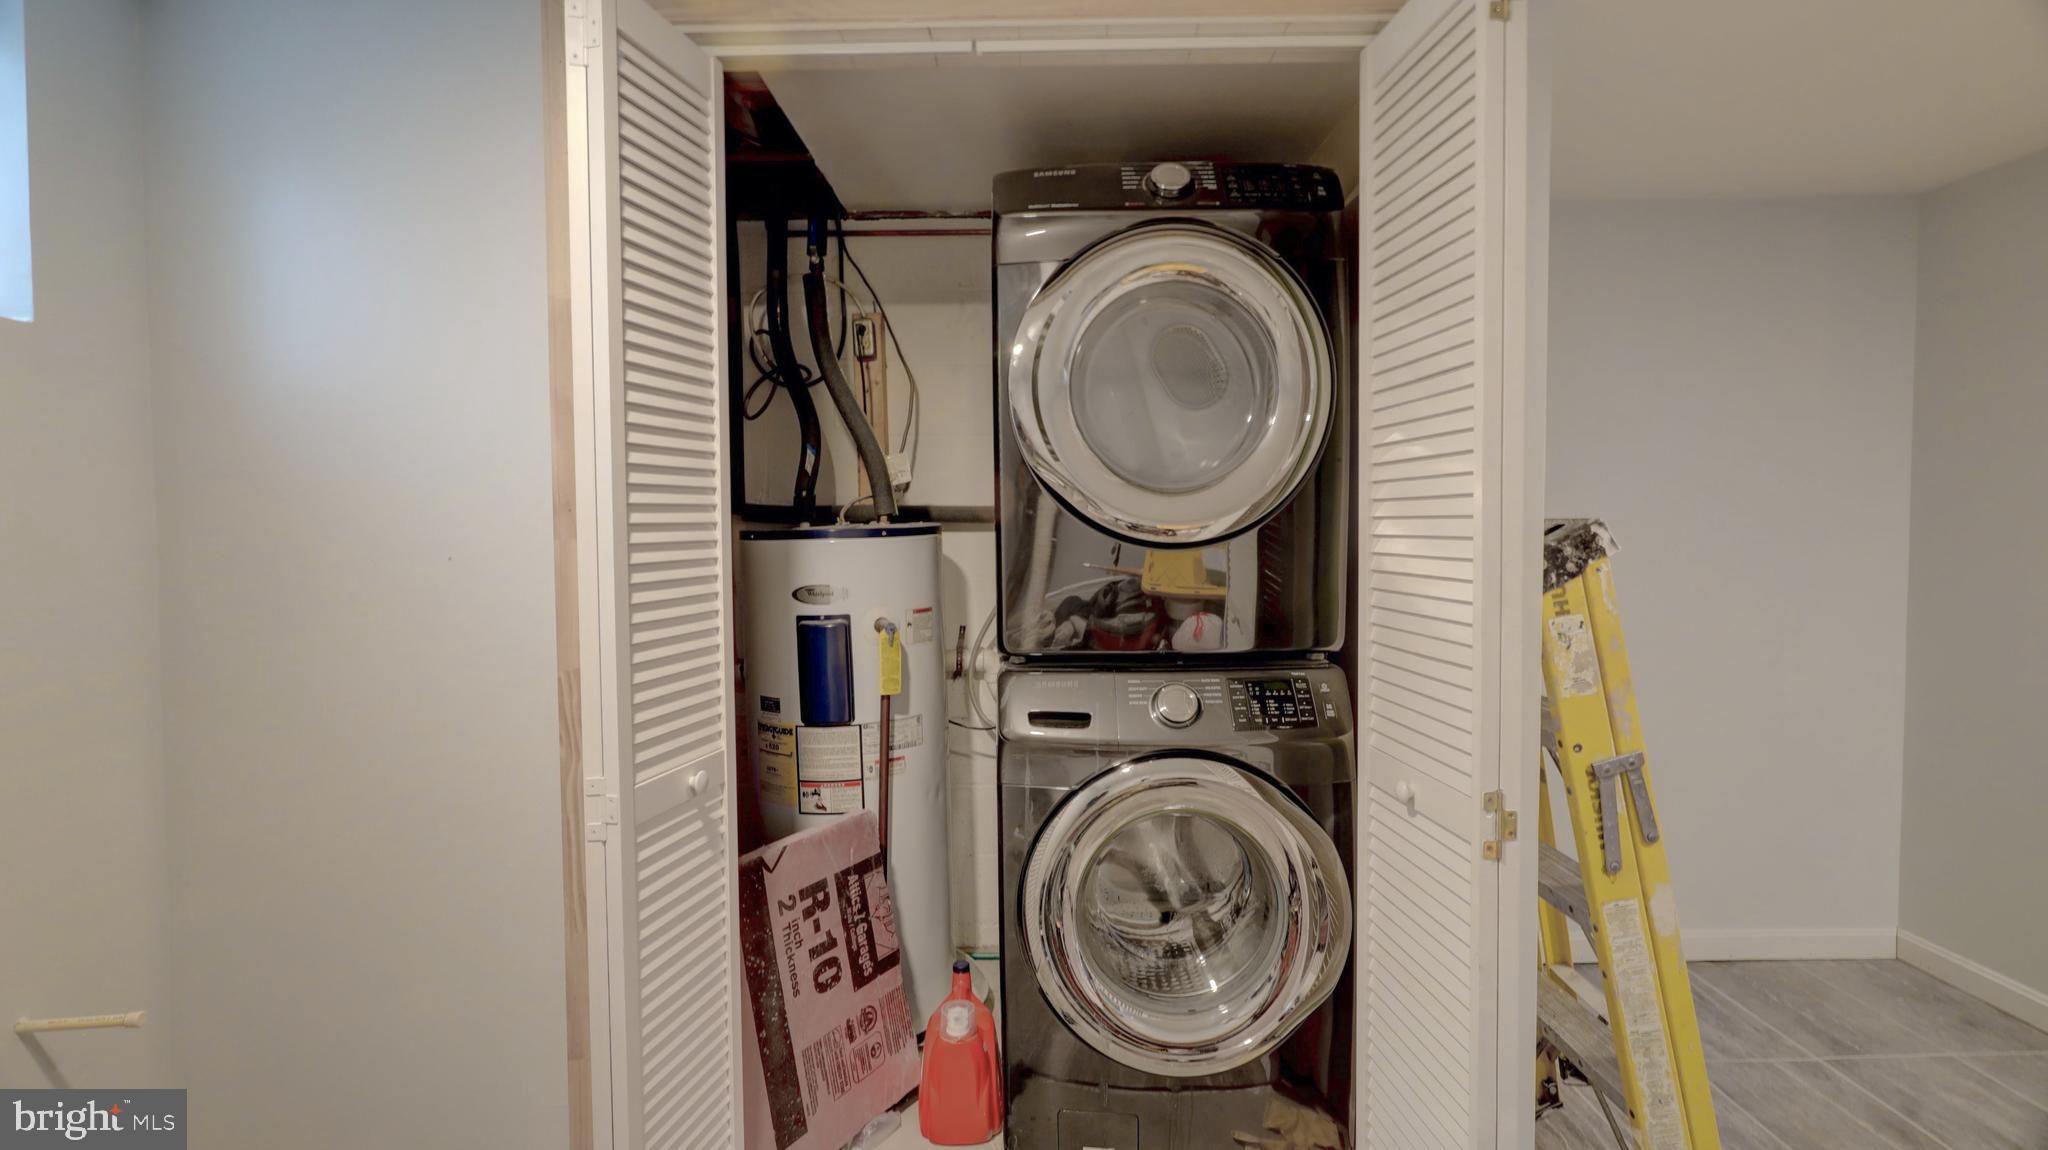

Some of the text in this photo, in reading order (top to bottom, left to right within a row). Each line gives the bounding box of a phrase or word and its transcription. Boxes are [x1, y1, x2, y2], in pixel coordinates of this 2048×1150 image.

[1033, 169, 1076, 178] SAMSUNG
[777, 893, 804, 950] 2 inch
[782, 921, 801, 999] Thickness
[798, 876, 843, 994] R-10
[847, 873, 862, 915] Attics
[856, 921, 874, 978] Garages
